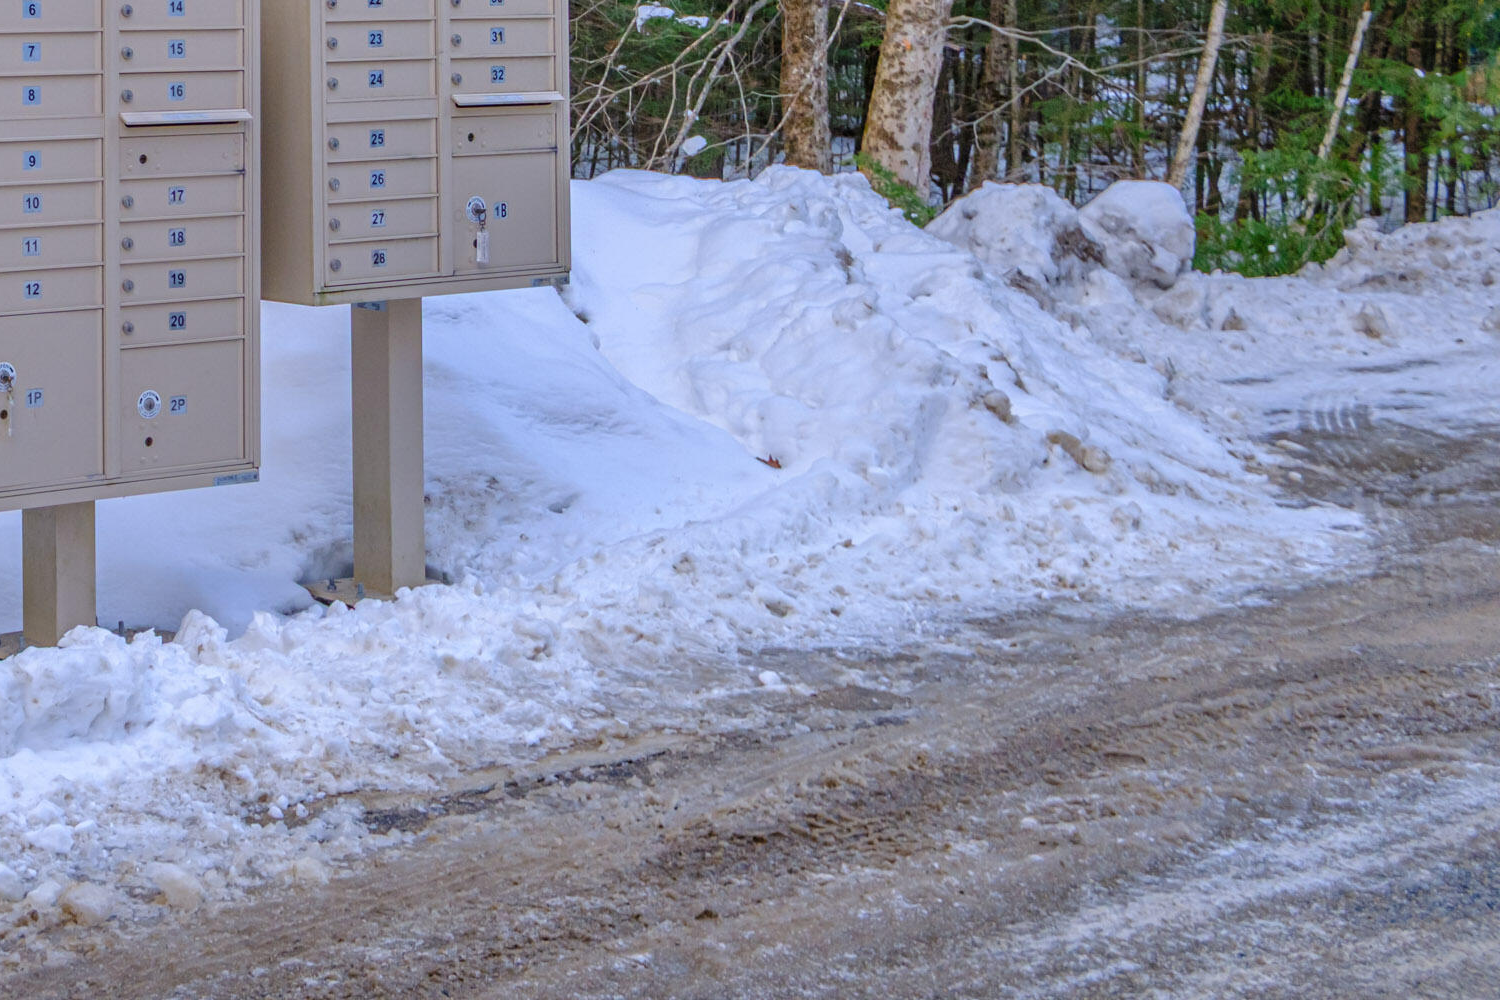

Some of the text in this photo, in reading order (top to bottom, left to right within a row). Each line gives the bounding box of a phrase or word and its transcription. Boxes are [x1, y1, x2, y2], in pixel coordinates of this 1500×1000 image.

[27, 3, 37, 16] 6
[170, 0, 183, 13] 14
[369, 33, 382, 45] 23
[491, 30, 503, 43] 31
[26, 45, 37, 58] 7
[170, 42, 184, 55] 15
[370, 73, 383, 86] 24
[492, 69, 504, 81] 32
[27, 88, 37, 102] 8
[170, 84, 184, 97] 16
[371, 133, 384, 146] 25
[27, 155, 38, 168] 9
[371, 173, 384, 186] 26
[171, 189, 184, 202] 17
[26, 196, 40, 209] 10
[372, 212, 385, 225] 27
[171, 231, 185, 244] 18
[25, 239, 38, 253] 11
[373, 252, 386, 265] 28
[171, 272, 185, 285] 19
[26, 283, 40, 296] 12
[170, 314, 185, 328] 20
[27, 391, 43, 405] 1P
[170, 398, 186, 412] 2P
